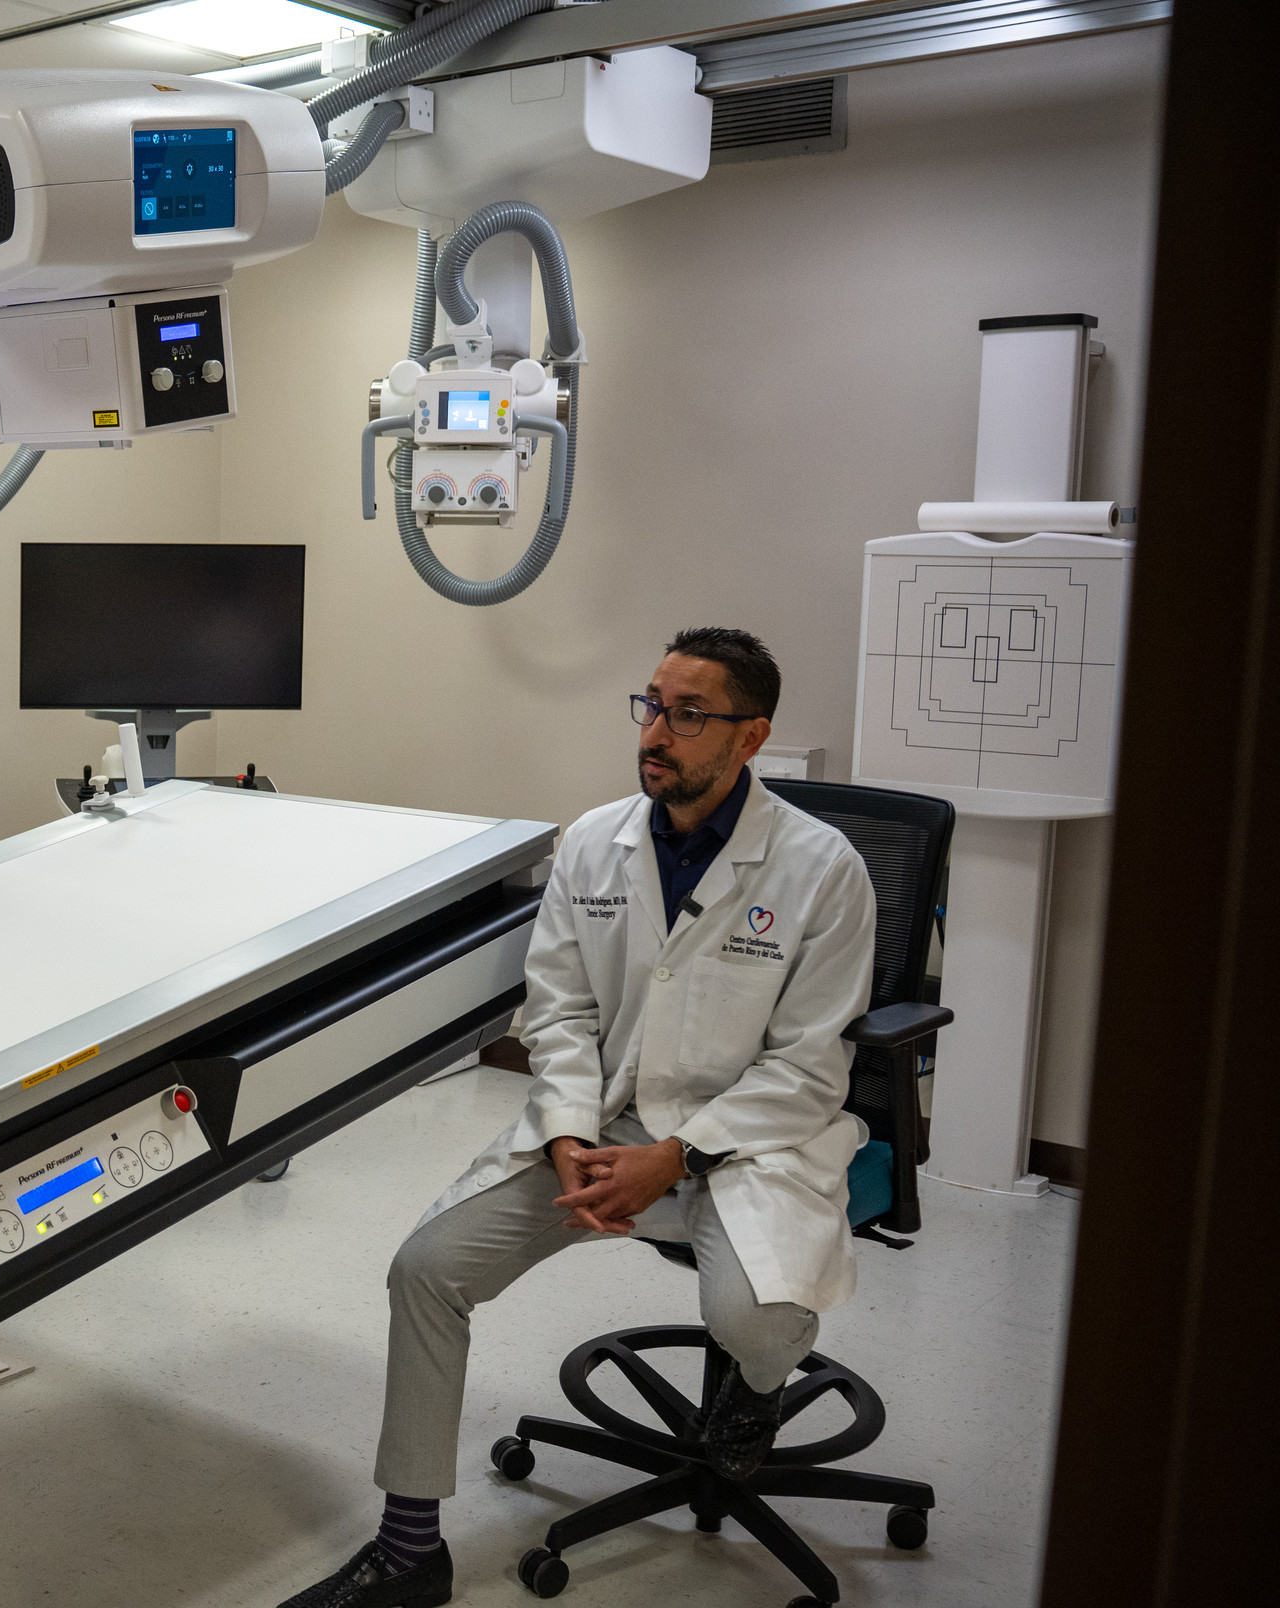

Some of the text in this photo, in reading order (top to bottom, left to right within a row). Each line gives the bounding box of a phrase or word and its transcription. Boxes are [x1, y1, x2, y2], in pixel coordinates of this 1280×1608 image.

[153, 314, 175, 322] Persona
[730, 935, 745, 944] Centro
[729, 944, 744, 953] Puerto
[746, 946, 756, 955] Rico
[18, 1168, 45, 1185] Persona
[45, 1160, 56, 1171] RF
